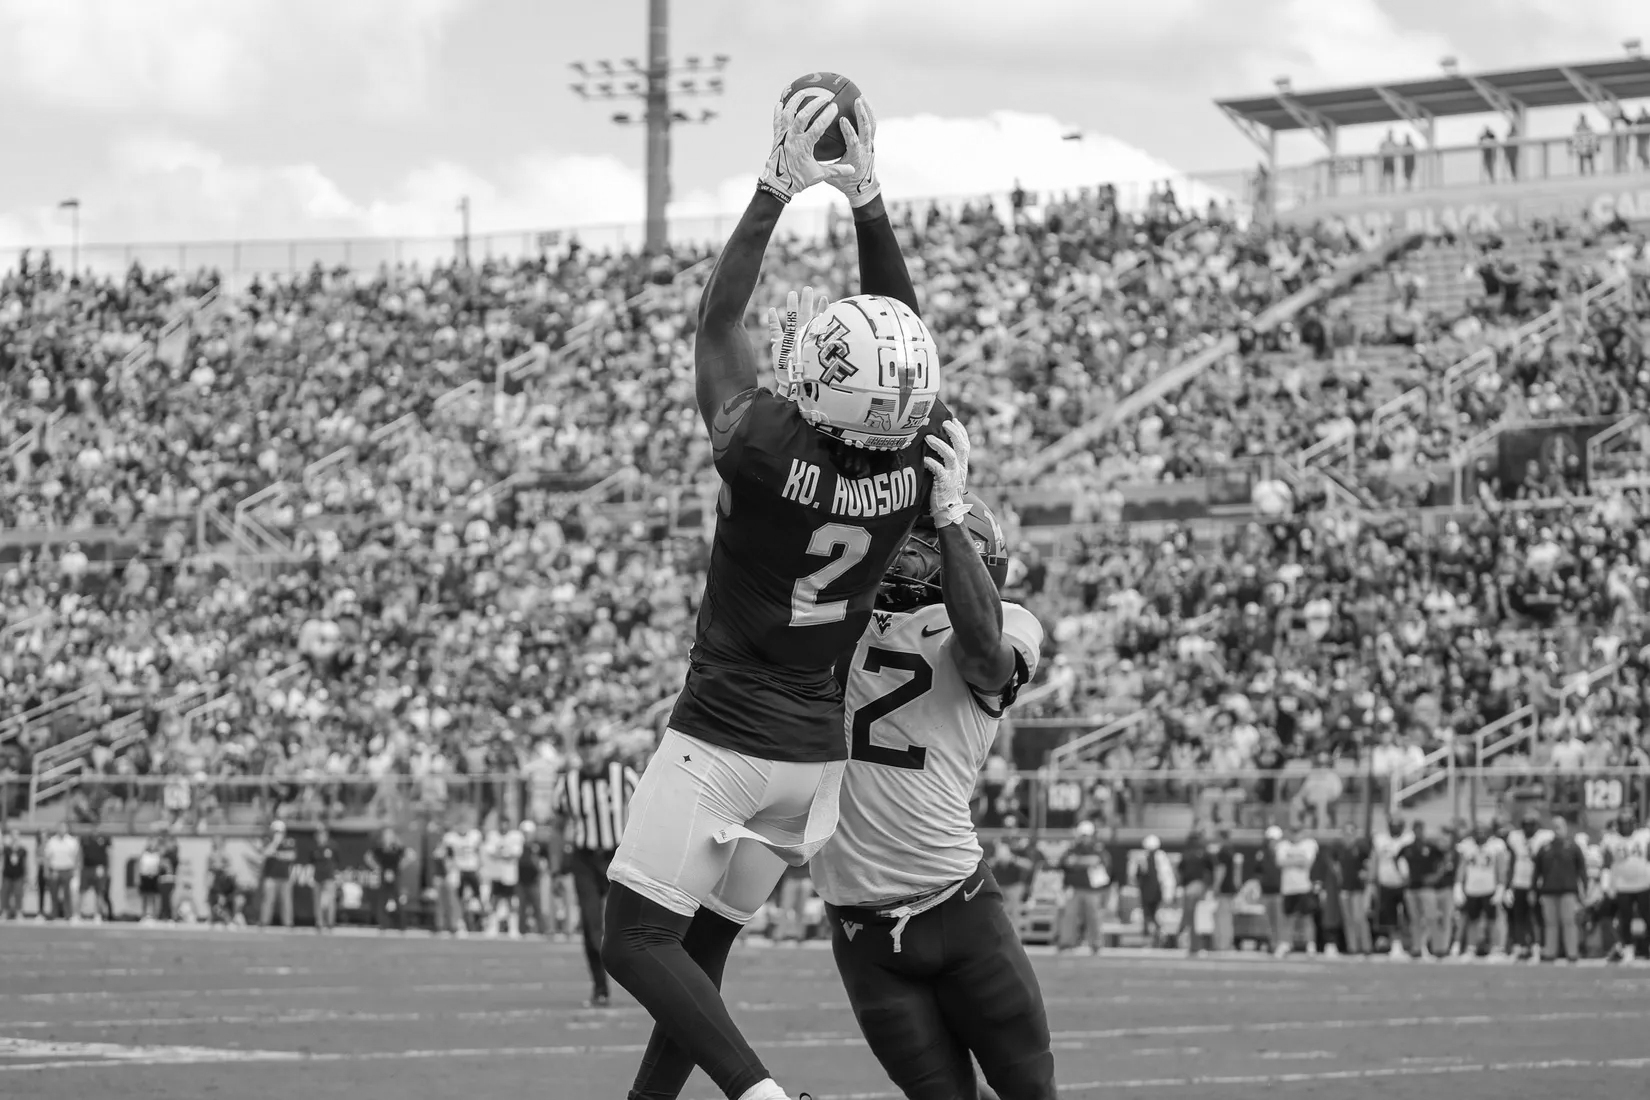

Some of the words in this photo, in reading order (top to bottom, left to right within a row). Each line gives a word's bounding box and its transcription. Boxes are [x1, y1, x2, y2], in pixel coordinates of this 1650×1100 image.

[778, 311, 797, 370] MOUNTAINEERS
[815, 315, 859, 386] UCF
[781, 458, 821, 508] KO.
[831, 466, 917, 517] HUDSON
[789, 521, 872, 627] 2
[851, 646, 934, 770] 2
